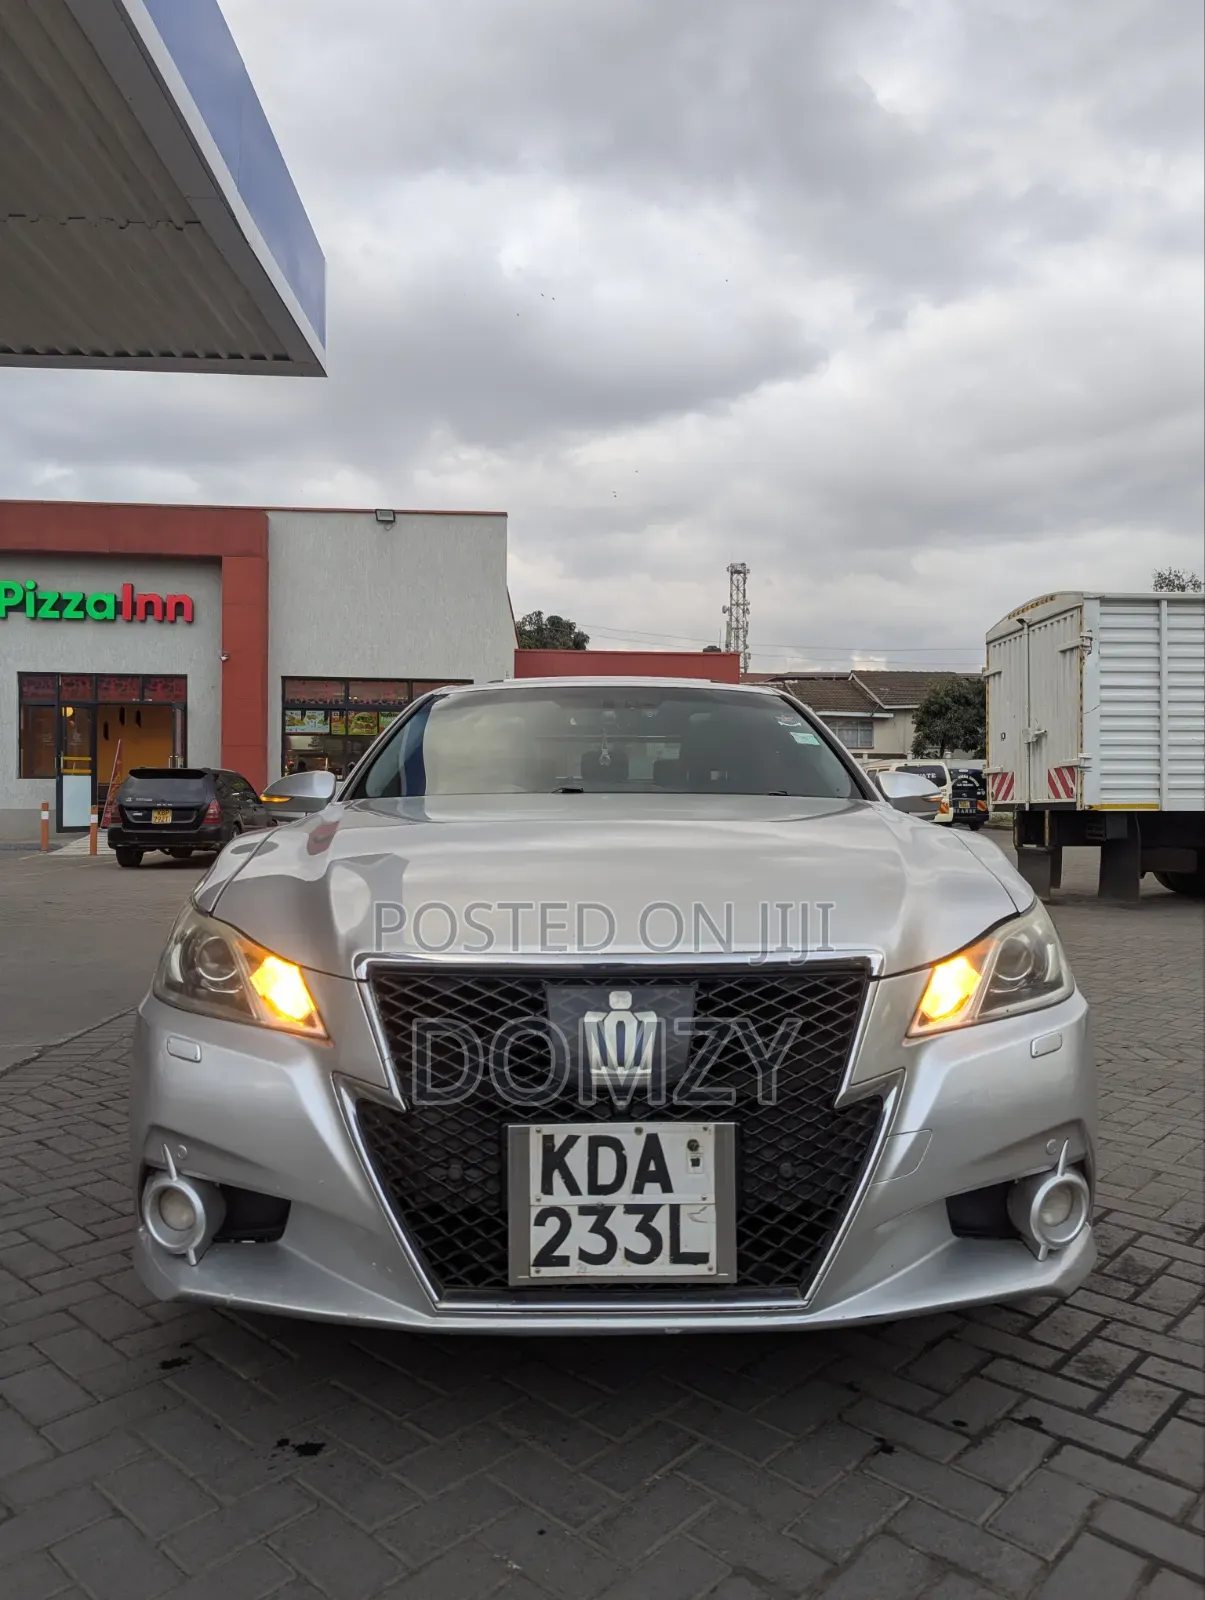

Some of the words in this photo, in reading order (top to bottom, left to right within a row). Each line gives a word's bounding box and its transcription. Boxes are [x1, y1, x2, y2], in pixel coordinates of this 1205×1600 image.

[0, 580, 117, 621] Pizza
[122, 583, 194, 623] Inn
[540, 1132, 674, 1196] KDA
[531, 1203, 710, 1267] 233L
